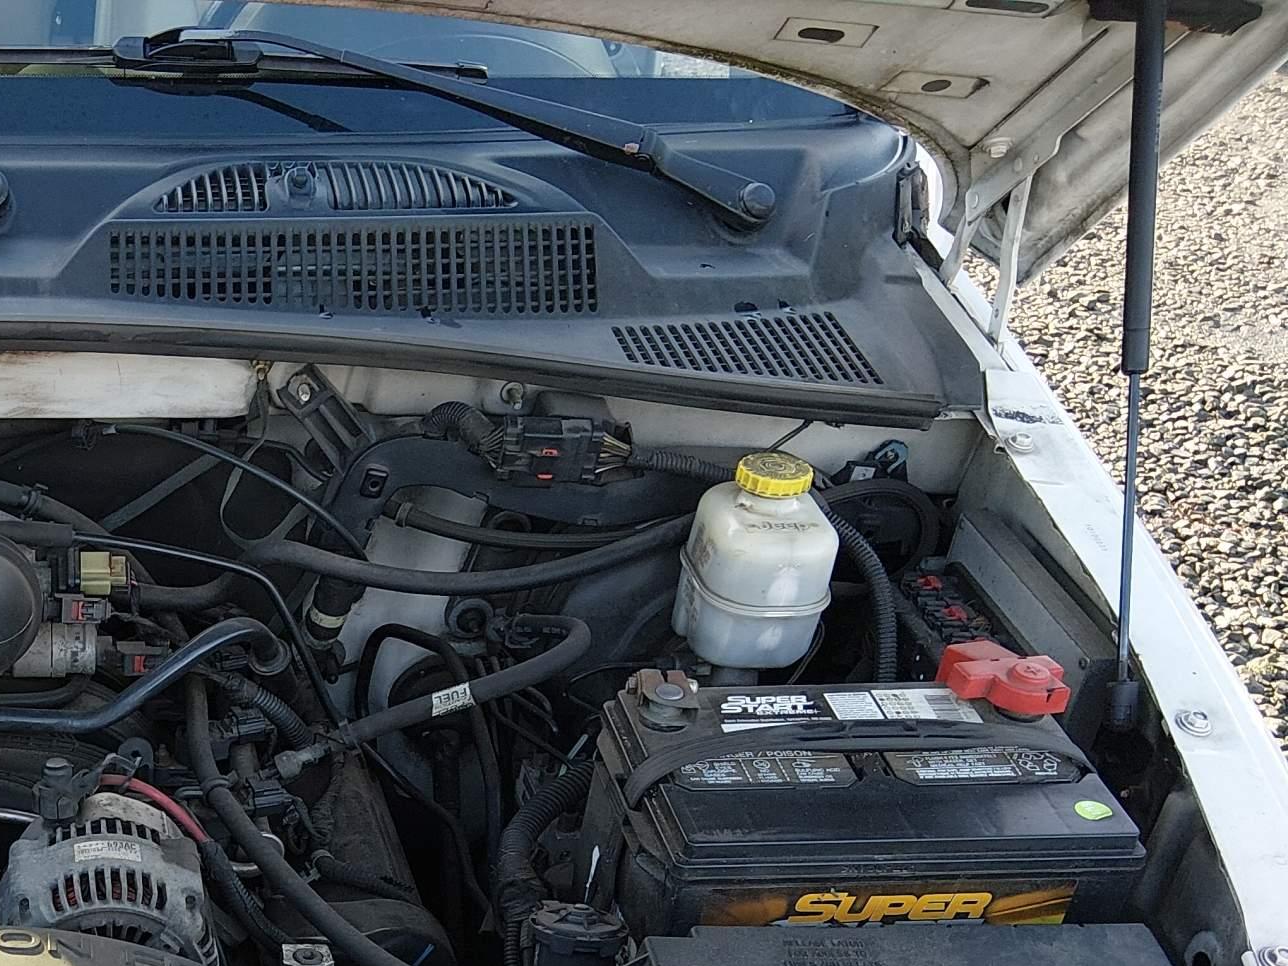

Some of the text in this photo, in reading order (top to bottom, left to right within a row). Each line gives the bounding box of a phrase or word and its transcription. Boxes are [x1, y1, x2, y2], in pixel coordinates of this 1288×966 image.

[434, 687, 467, 705] FUEL
[727, 695, 807, 704] SUPER
[721, 702, 813, 714] START
[766, 750, 812, 758] POISON
[788, 892, 992, 923] SUPER
